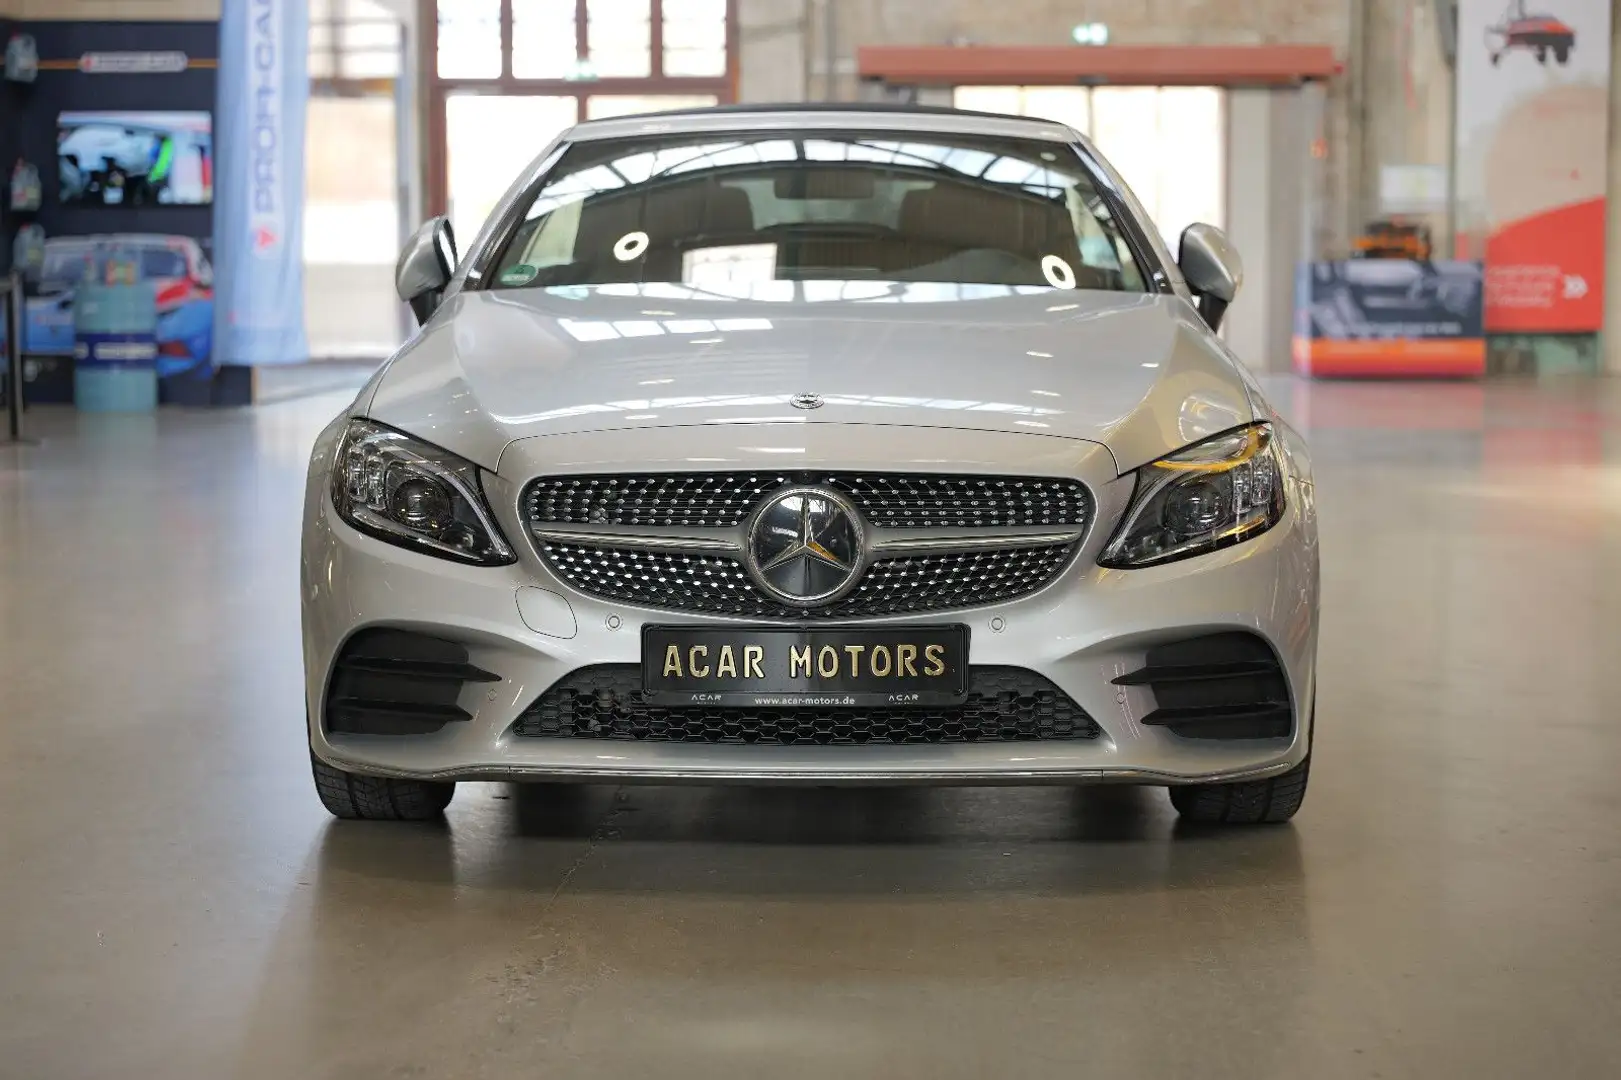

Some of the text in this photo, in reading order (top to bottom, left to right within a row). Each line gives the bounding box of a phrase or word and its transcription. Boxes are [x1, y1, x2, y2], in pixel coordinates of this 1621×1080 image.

[662, 644, 945, 678] ACAR MOTORS
[691, 693, 722, 701] ACAR
[754, 695, 856, 706] www.acar-motors.de
[888, 693, 919, 702] ACAR
